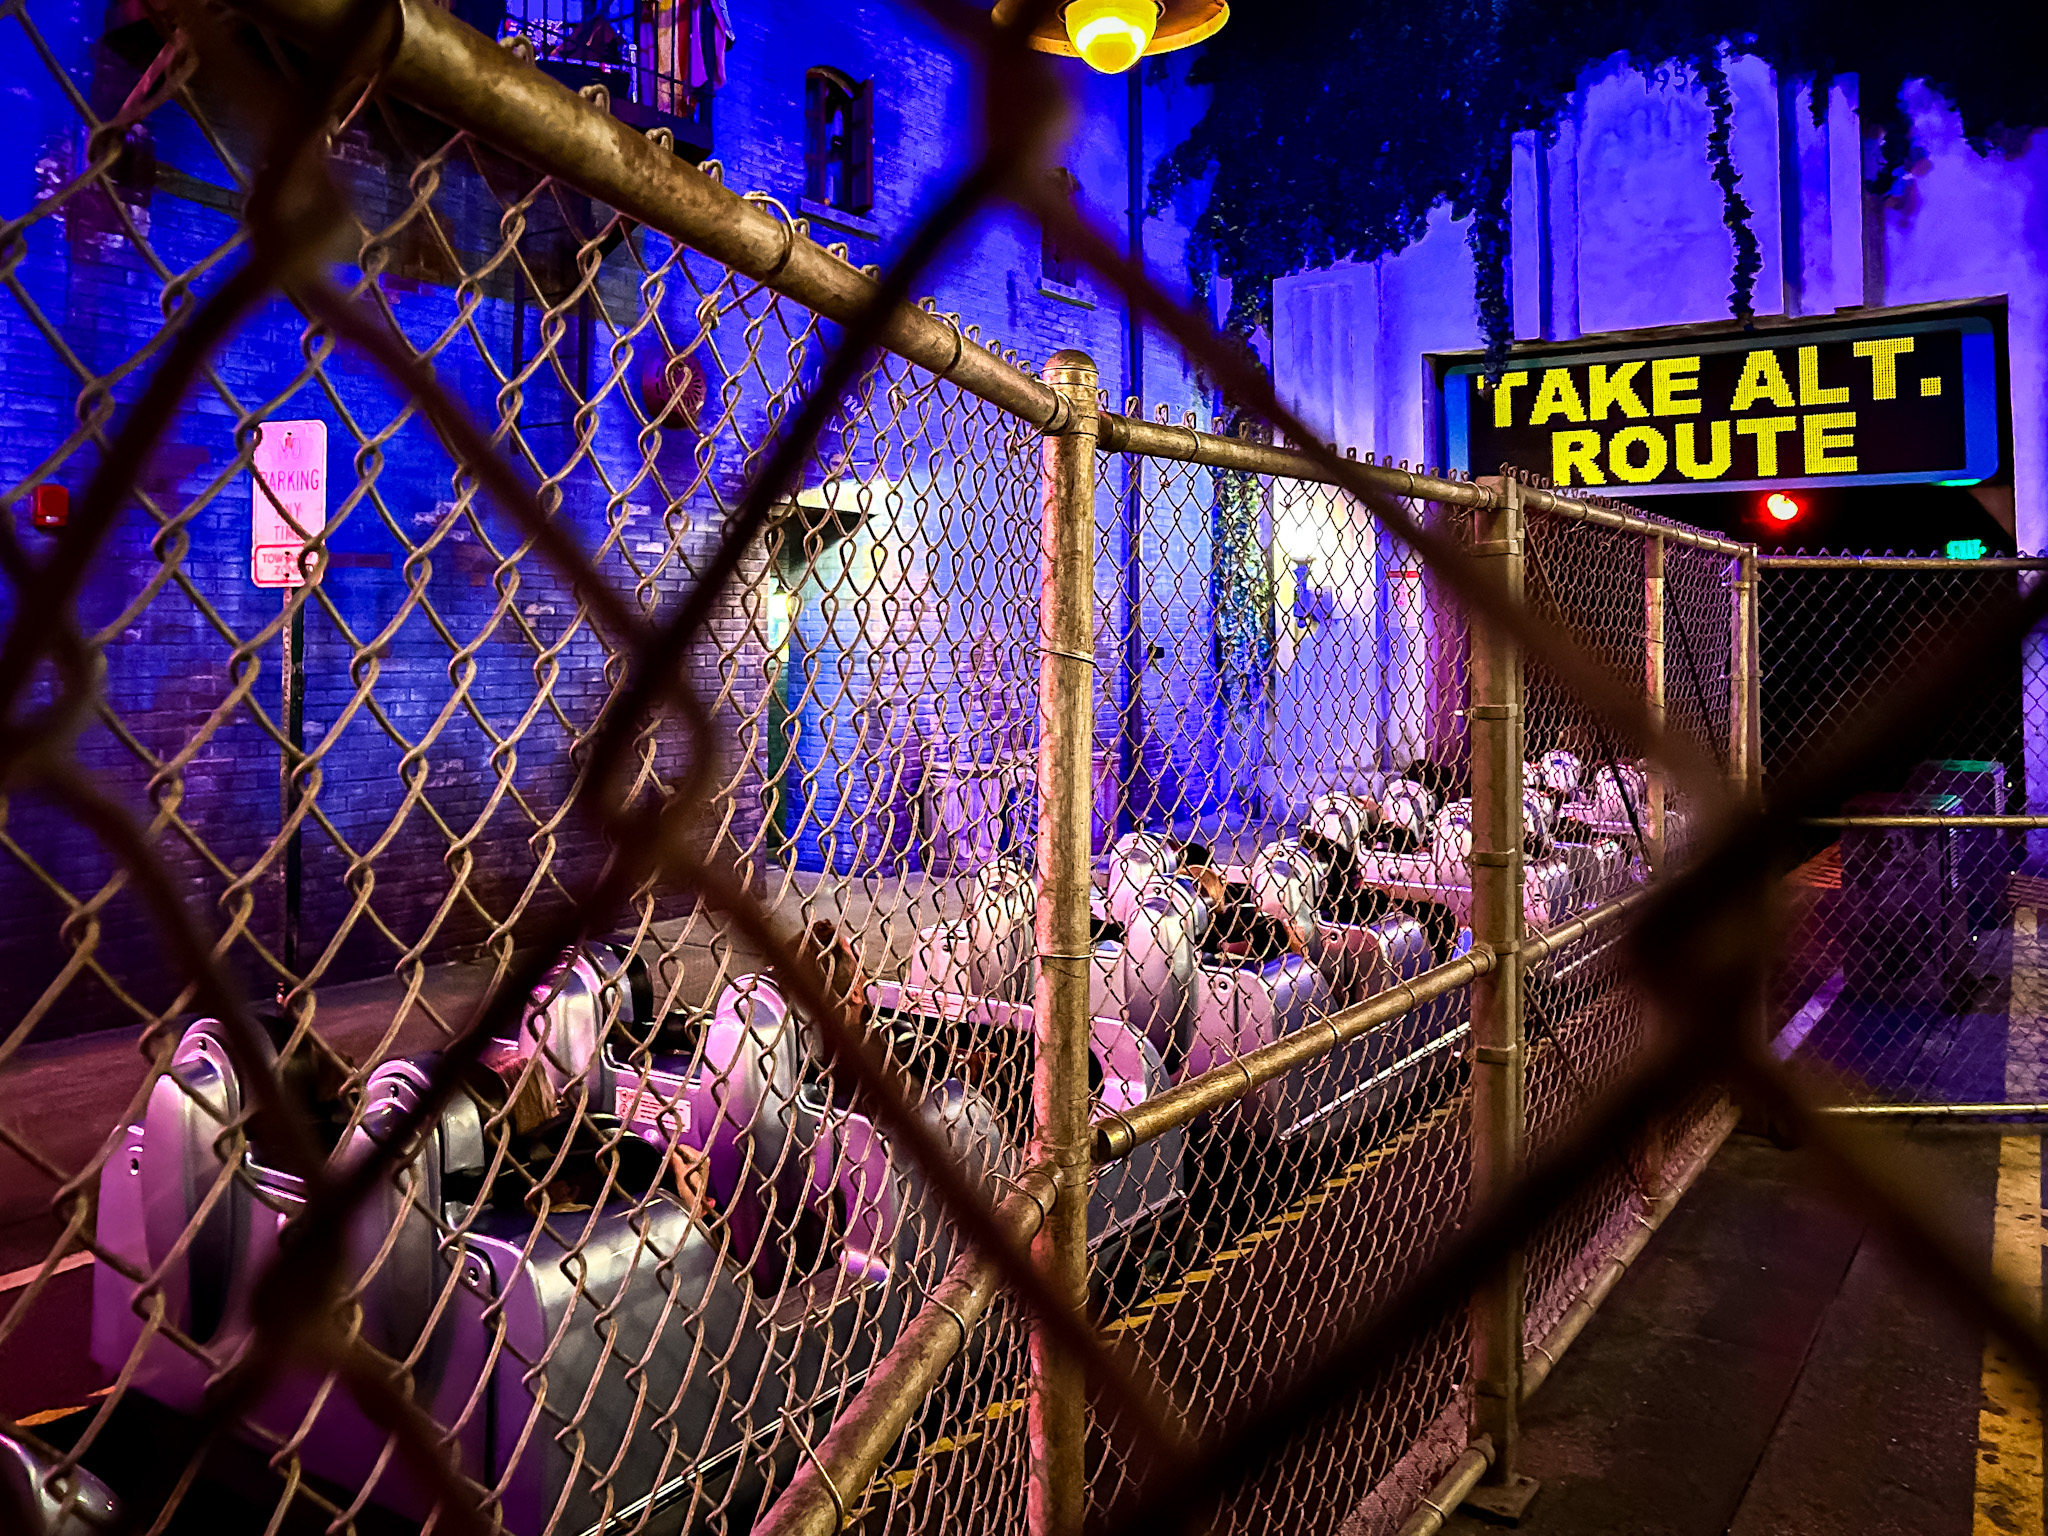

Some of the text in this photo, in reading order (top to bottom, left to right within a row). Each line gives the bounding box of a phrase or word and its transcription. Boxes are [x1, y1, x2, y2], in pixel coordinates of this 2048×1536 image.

[1477, 336, 1942, 428] TAKE ALT.
[277, 437, 301, 459] NO
[1551, 411, 1858, 487] ROUTE
[274, 502, 302, 520] NY
[274, 525, 303, 541] TIM
